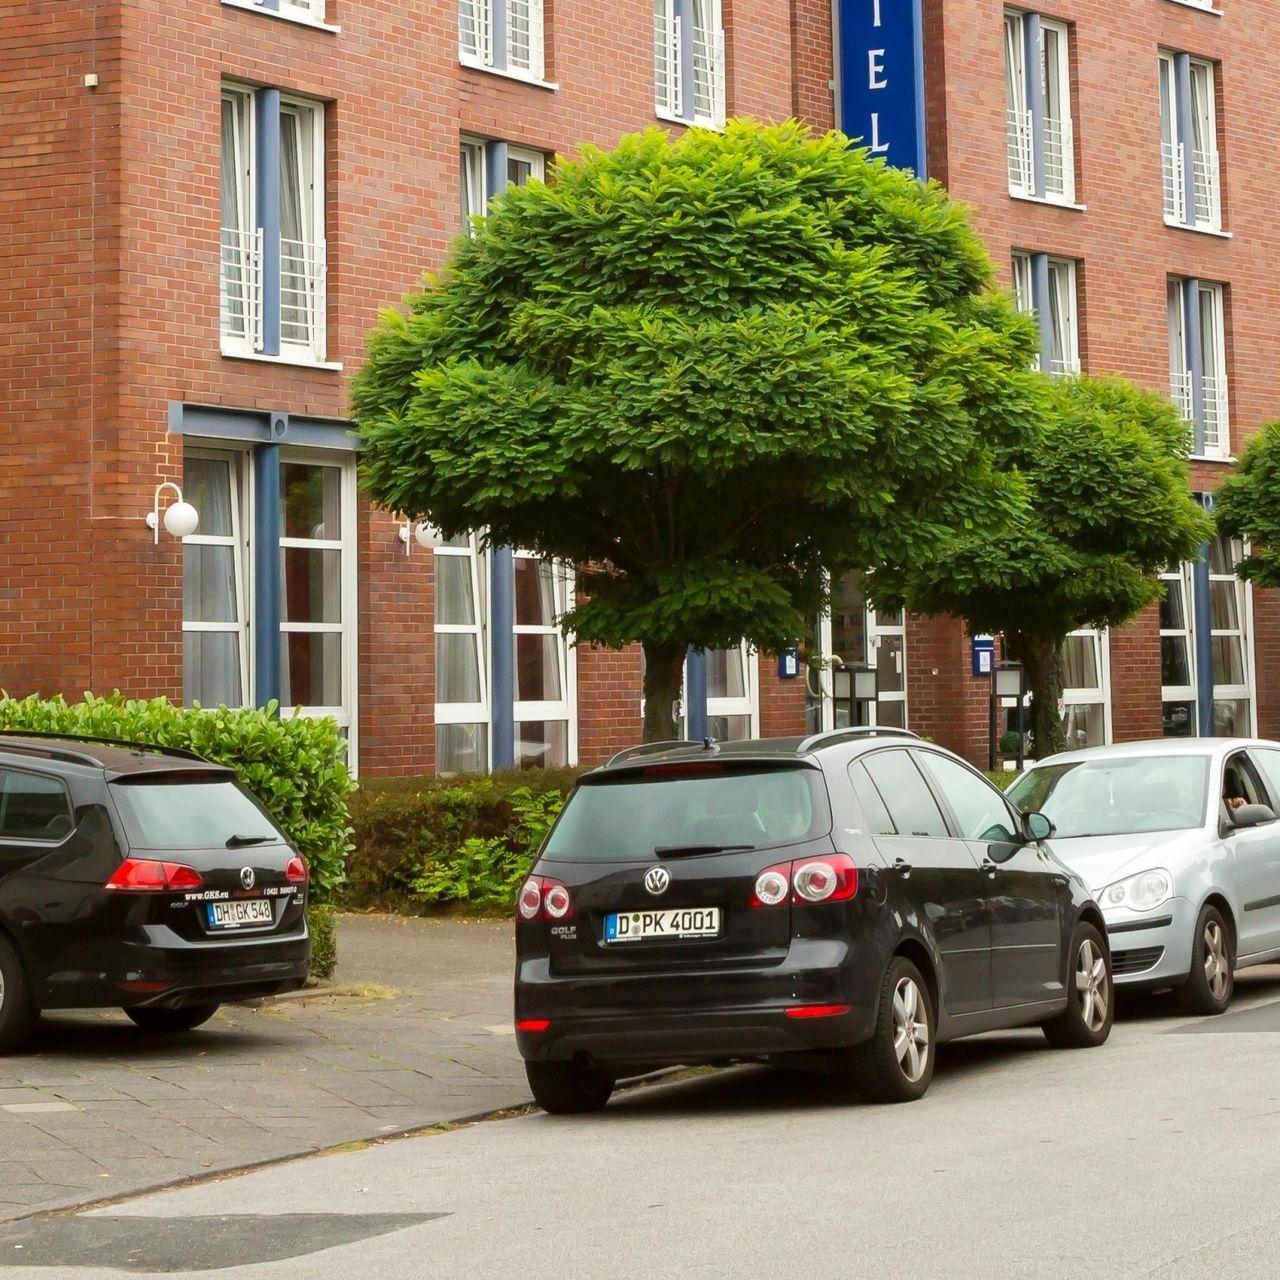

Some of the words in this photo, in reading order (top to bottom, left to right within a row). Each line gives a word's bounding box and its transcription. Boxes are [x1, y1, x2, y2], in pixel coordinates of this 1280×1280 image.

[185, 890, 229, 900] www.GKS.eu
[215, 904, 230, 922] DH
[235, 903, 251, 920] GK
[251, 901, 271, 919] 548
[618, 915, 630, 935] D
[642, 912, 666, 933] PK
[670, 910, 716, 931] 4001
[551, 926, 576, 935] GOLF
